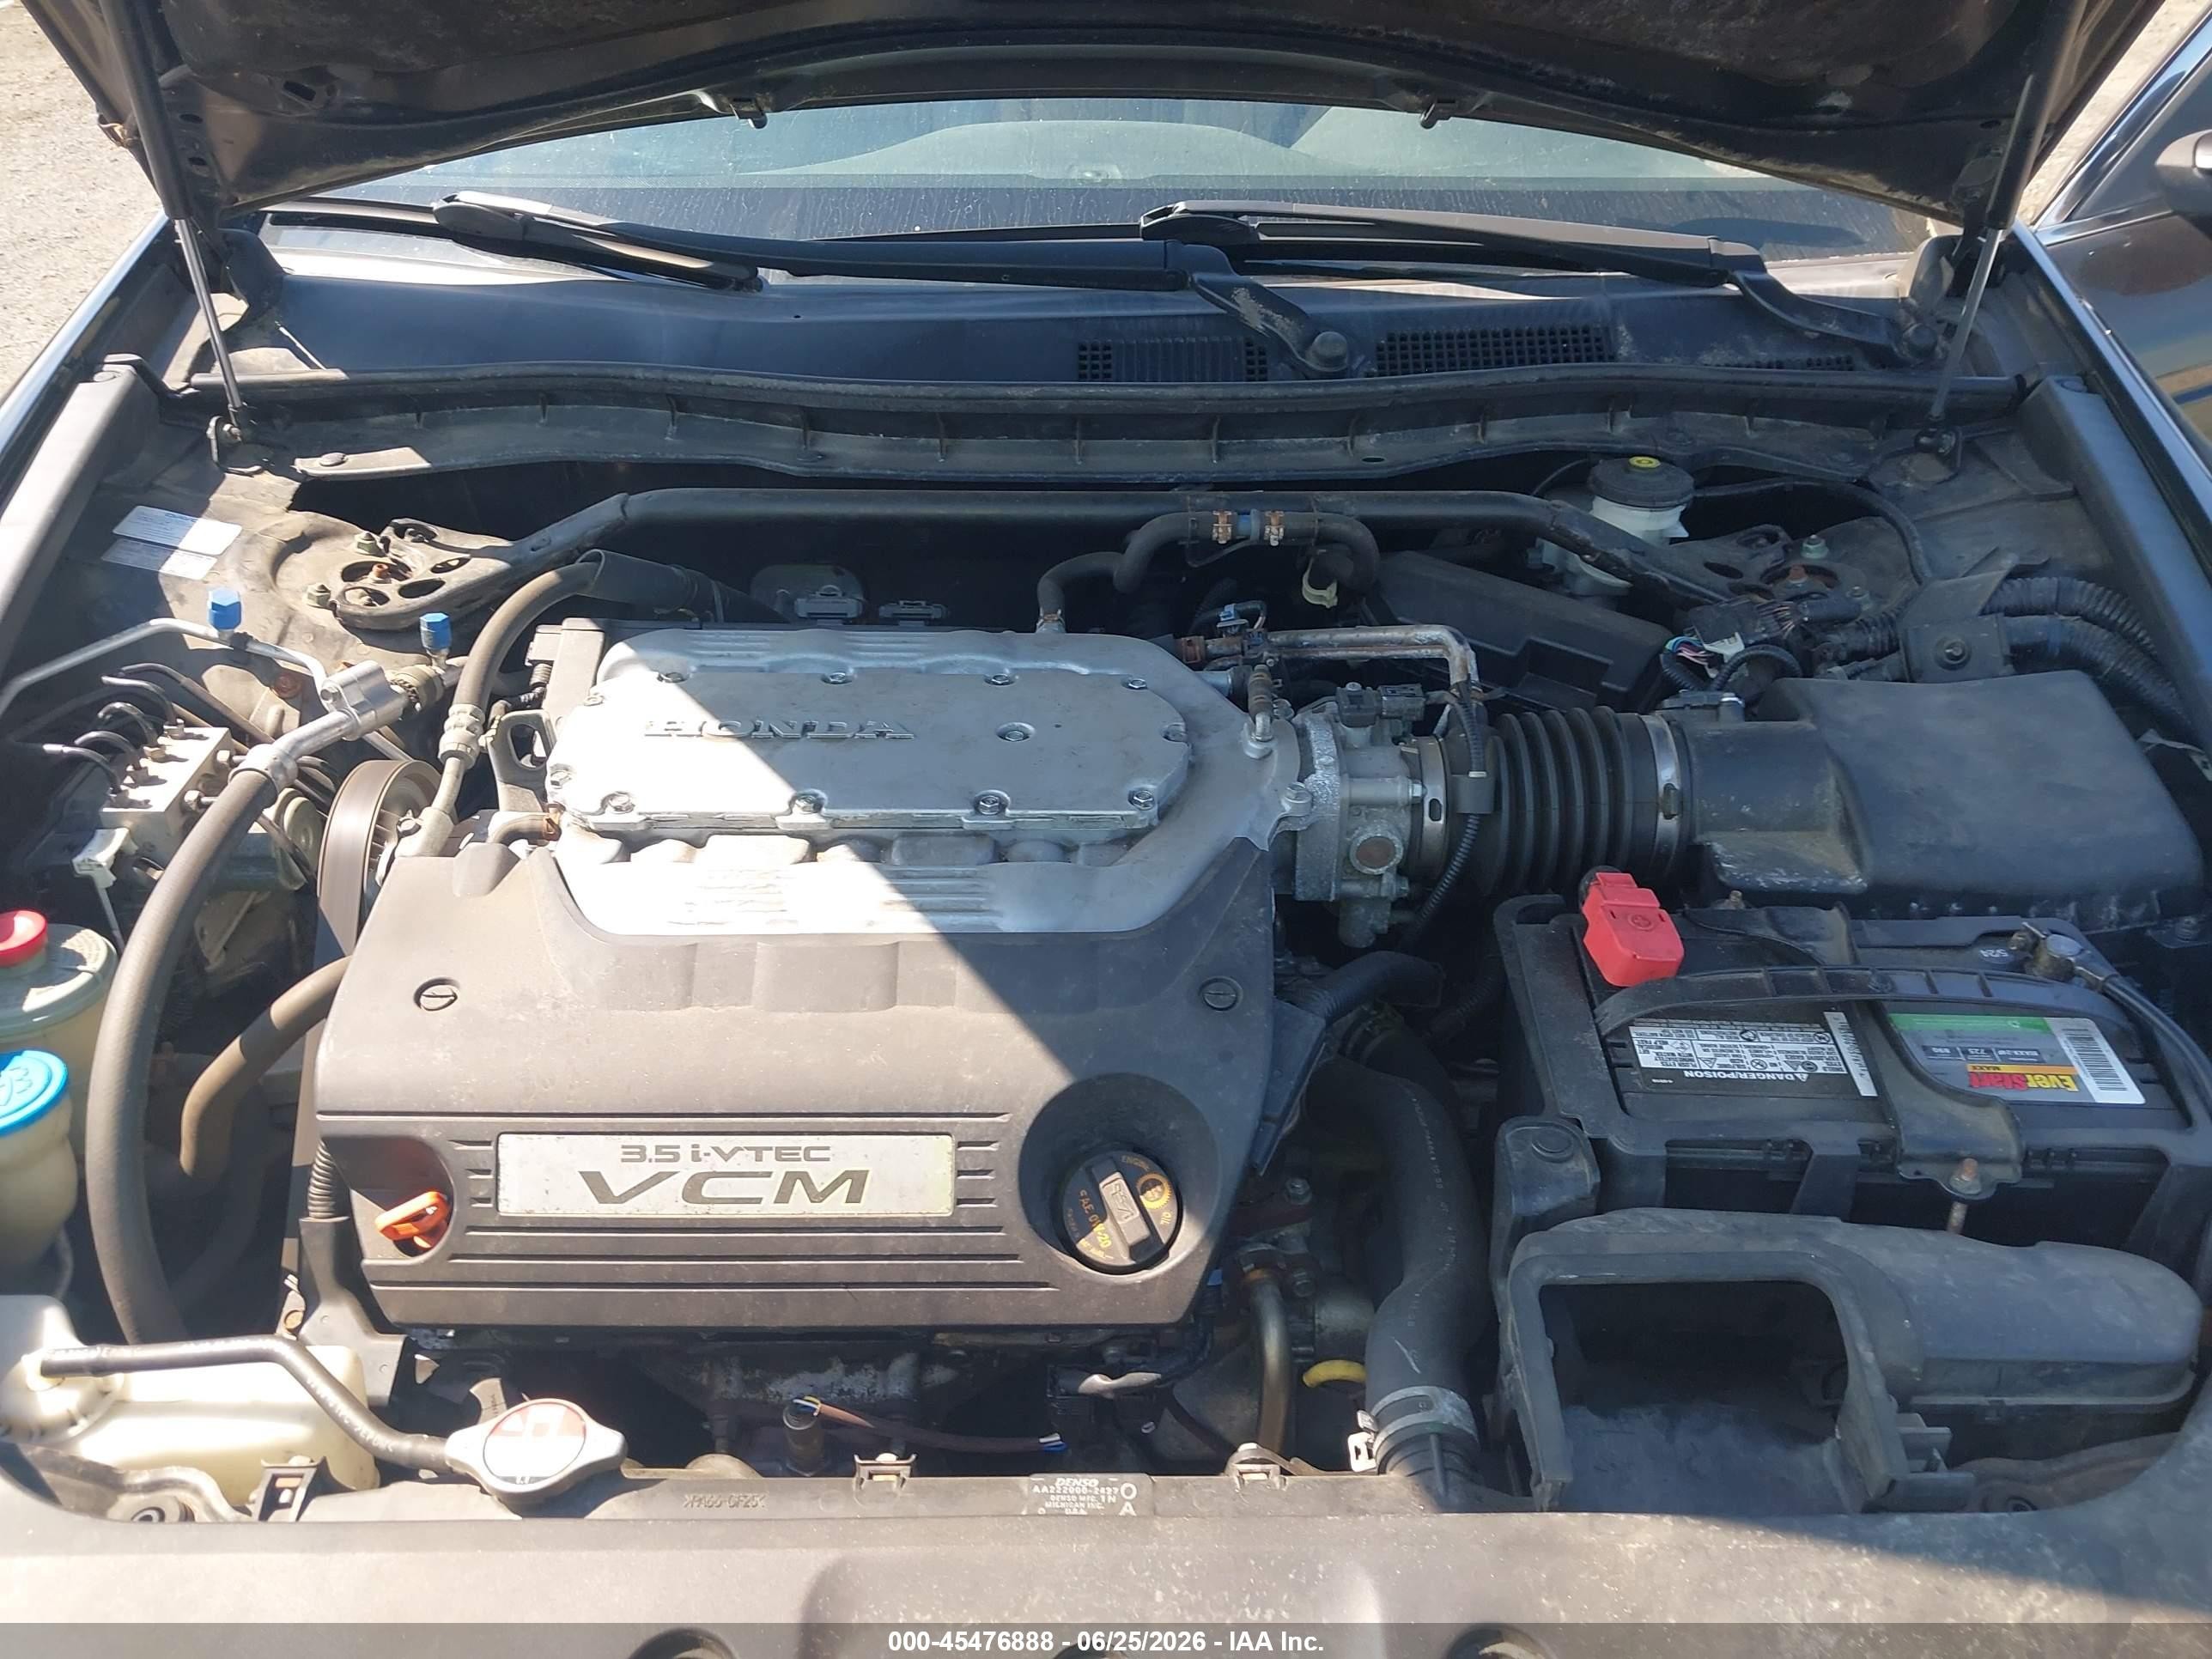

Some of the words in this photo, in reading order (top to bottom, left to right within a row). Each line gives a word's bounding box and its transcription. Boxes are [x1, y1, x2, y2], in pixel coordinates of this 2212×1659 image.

[644, 720, 915, 739] HONDA
[1683, 1069, 1796, 1081] DANGER/POISON
[1969, 1072, 2079, 1092] EverStart
[621, 1145, 681, 1163] 3.5
[691, 1144, 831, 1163] i-VTEC
[579, 1170, 870, 1204] VCM
[1079, 1189, 1095, 1214] SAE
[1089, 1214, 1112, 1248] 0W-20
[1160, 1212, 1172, 1225] OIL
[1055, 1478, 1100, 1487] DENSO
